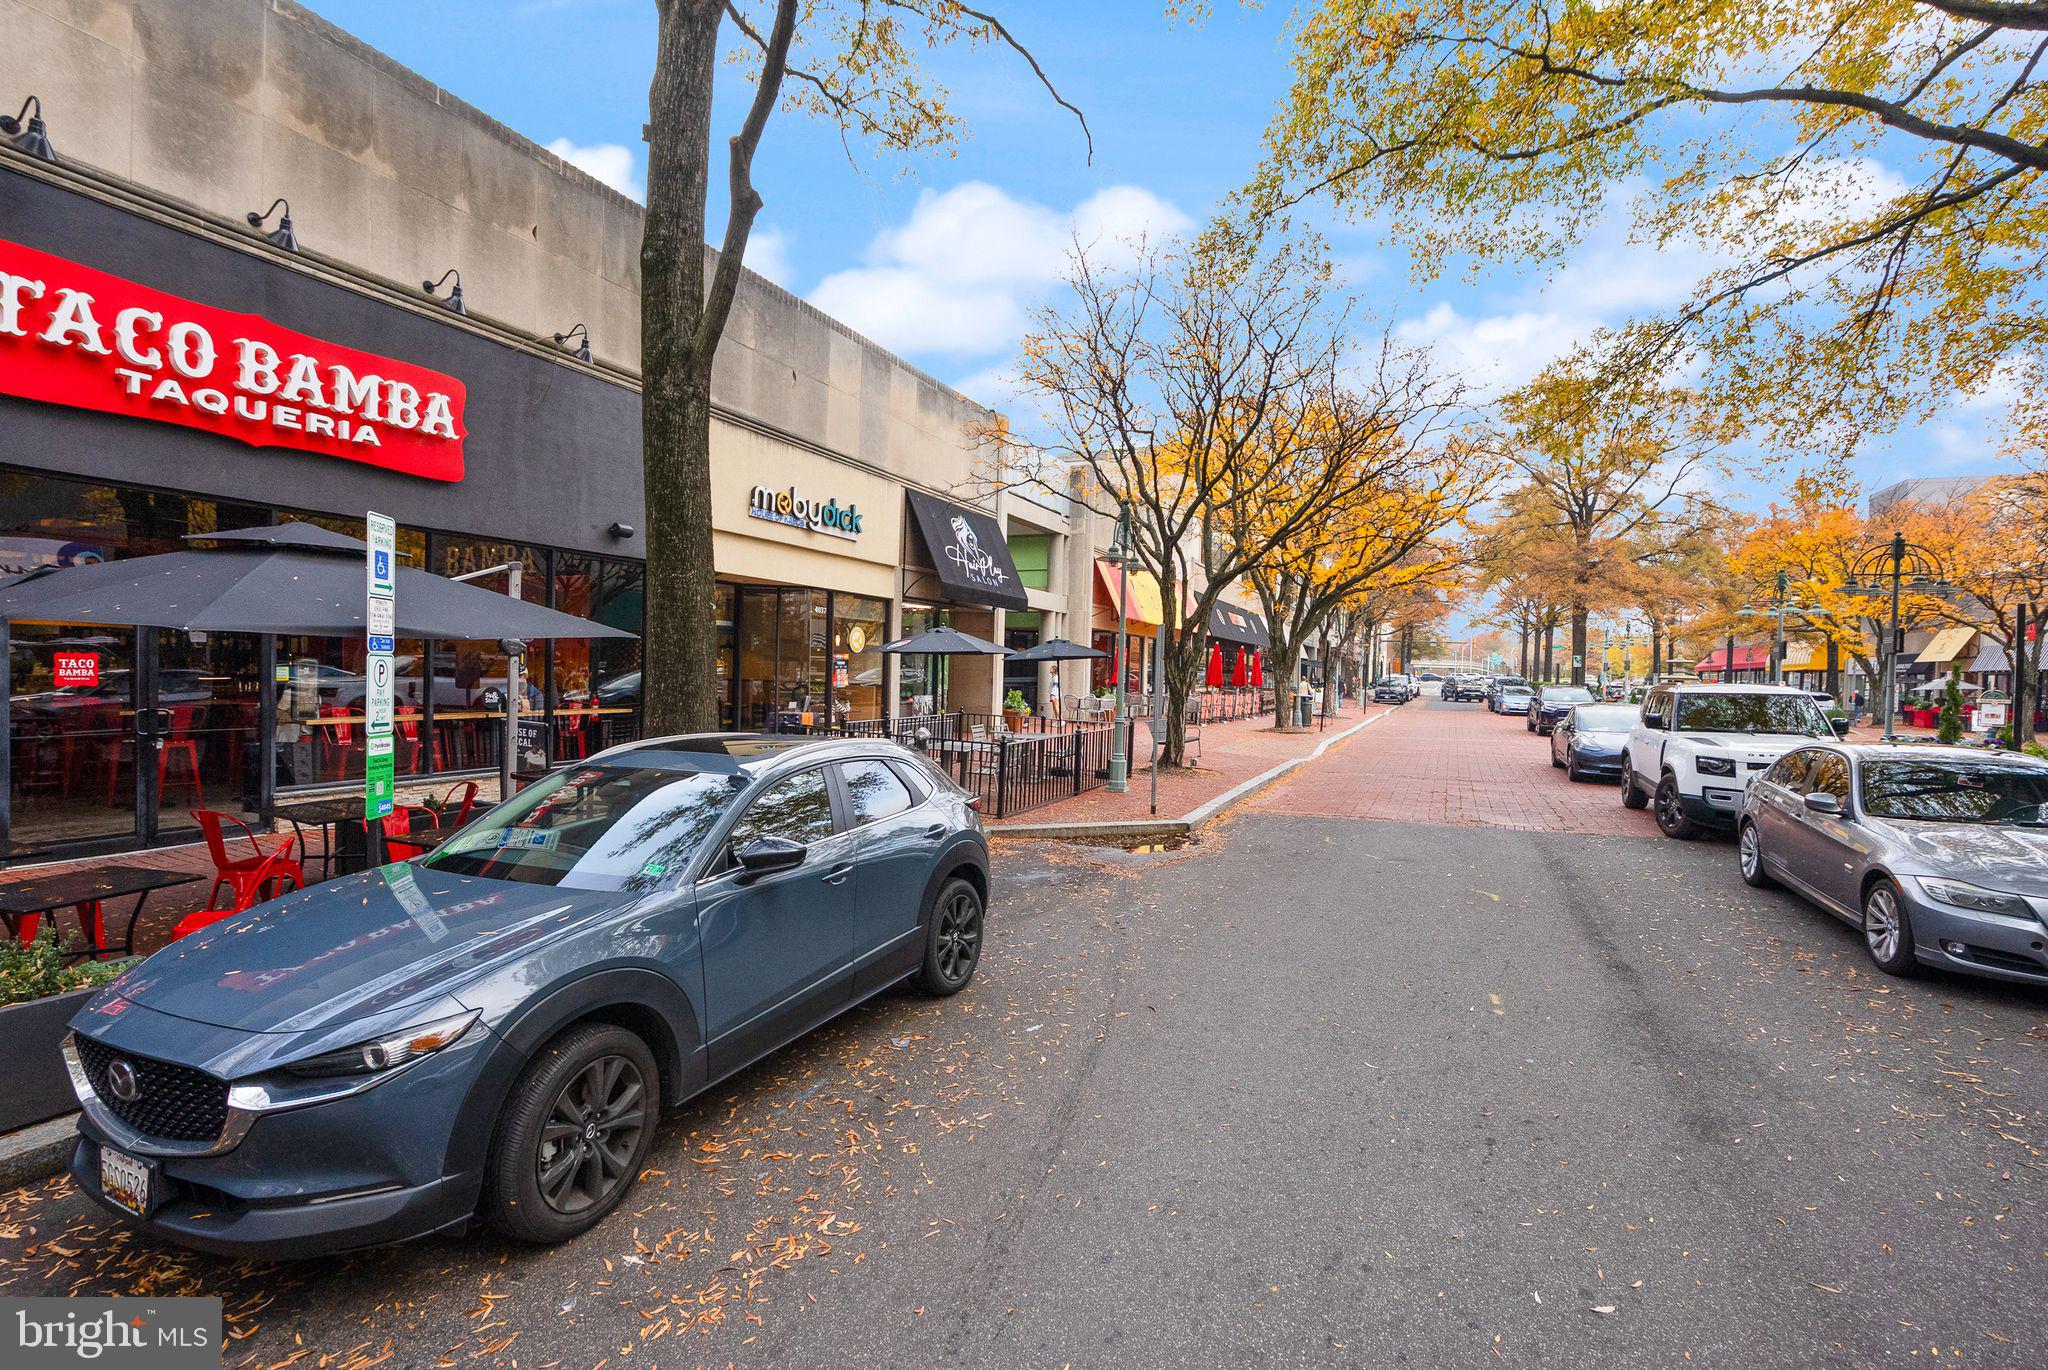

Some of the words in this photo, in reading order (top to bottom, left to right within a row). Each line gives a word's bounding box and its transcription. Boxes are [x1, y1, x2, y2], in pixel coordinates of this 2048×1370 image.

[0, 272, 218, 378] TACO
[233, 337, 461, 440] BAMBA
[114, 368, 382, 447] TAQUERIA
[970, 573, 999, 587] SALON
[58, 658, 95, 669] TACO
[58, 668, 95, 677] BAMBA
[528, 729, 538, 738] OF
